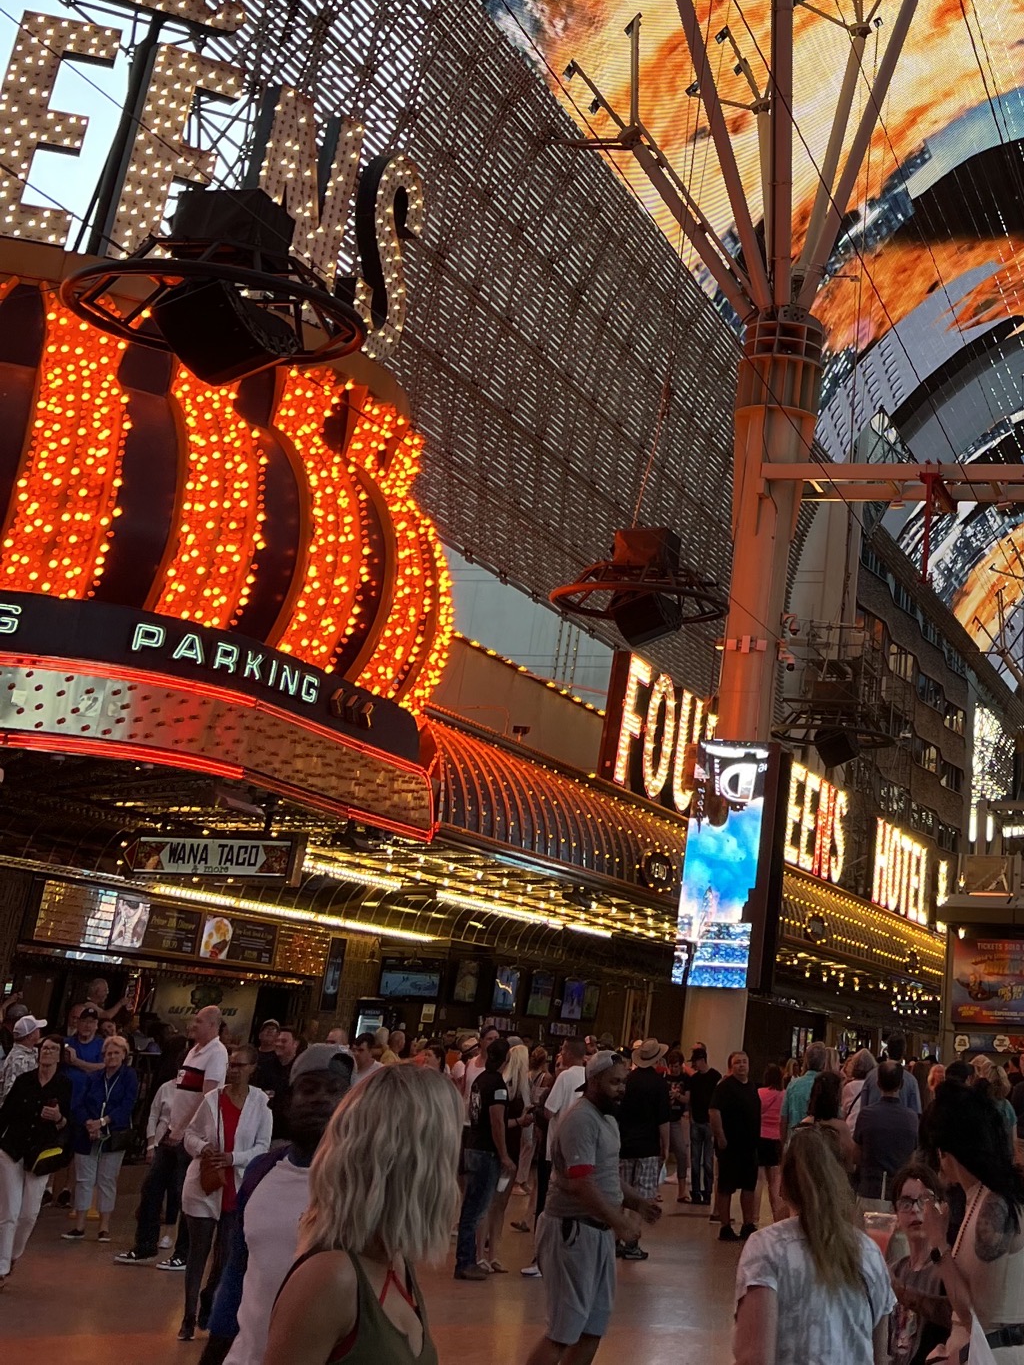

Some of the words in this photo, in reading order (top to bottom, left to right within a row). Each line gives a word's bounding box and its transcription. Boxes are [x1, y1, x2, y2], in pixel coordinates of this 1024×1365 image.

[131, 622, 322, 704] PARKING
[613, 652, 719, 813] FOU
[871, 817, 928, 925] HOTEL
[168, 842, 209, 865] WANA
[217, 843, 261, 866] TACO
[203, 865, 229, 874] more
[977, 942, 1003, 951] TICKETS
[1004, 943, 1021, 951] SOLD
